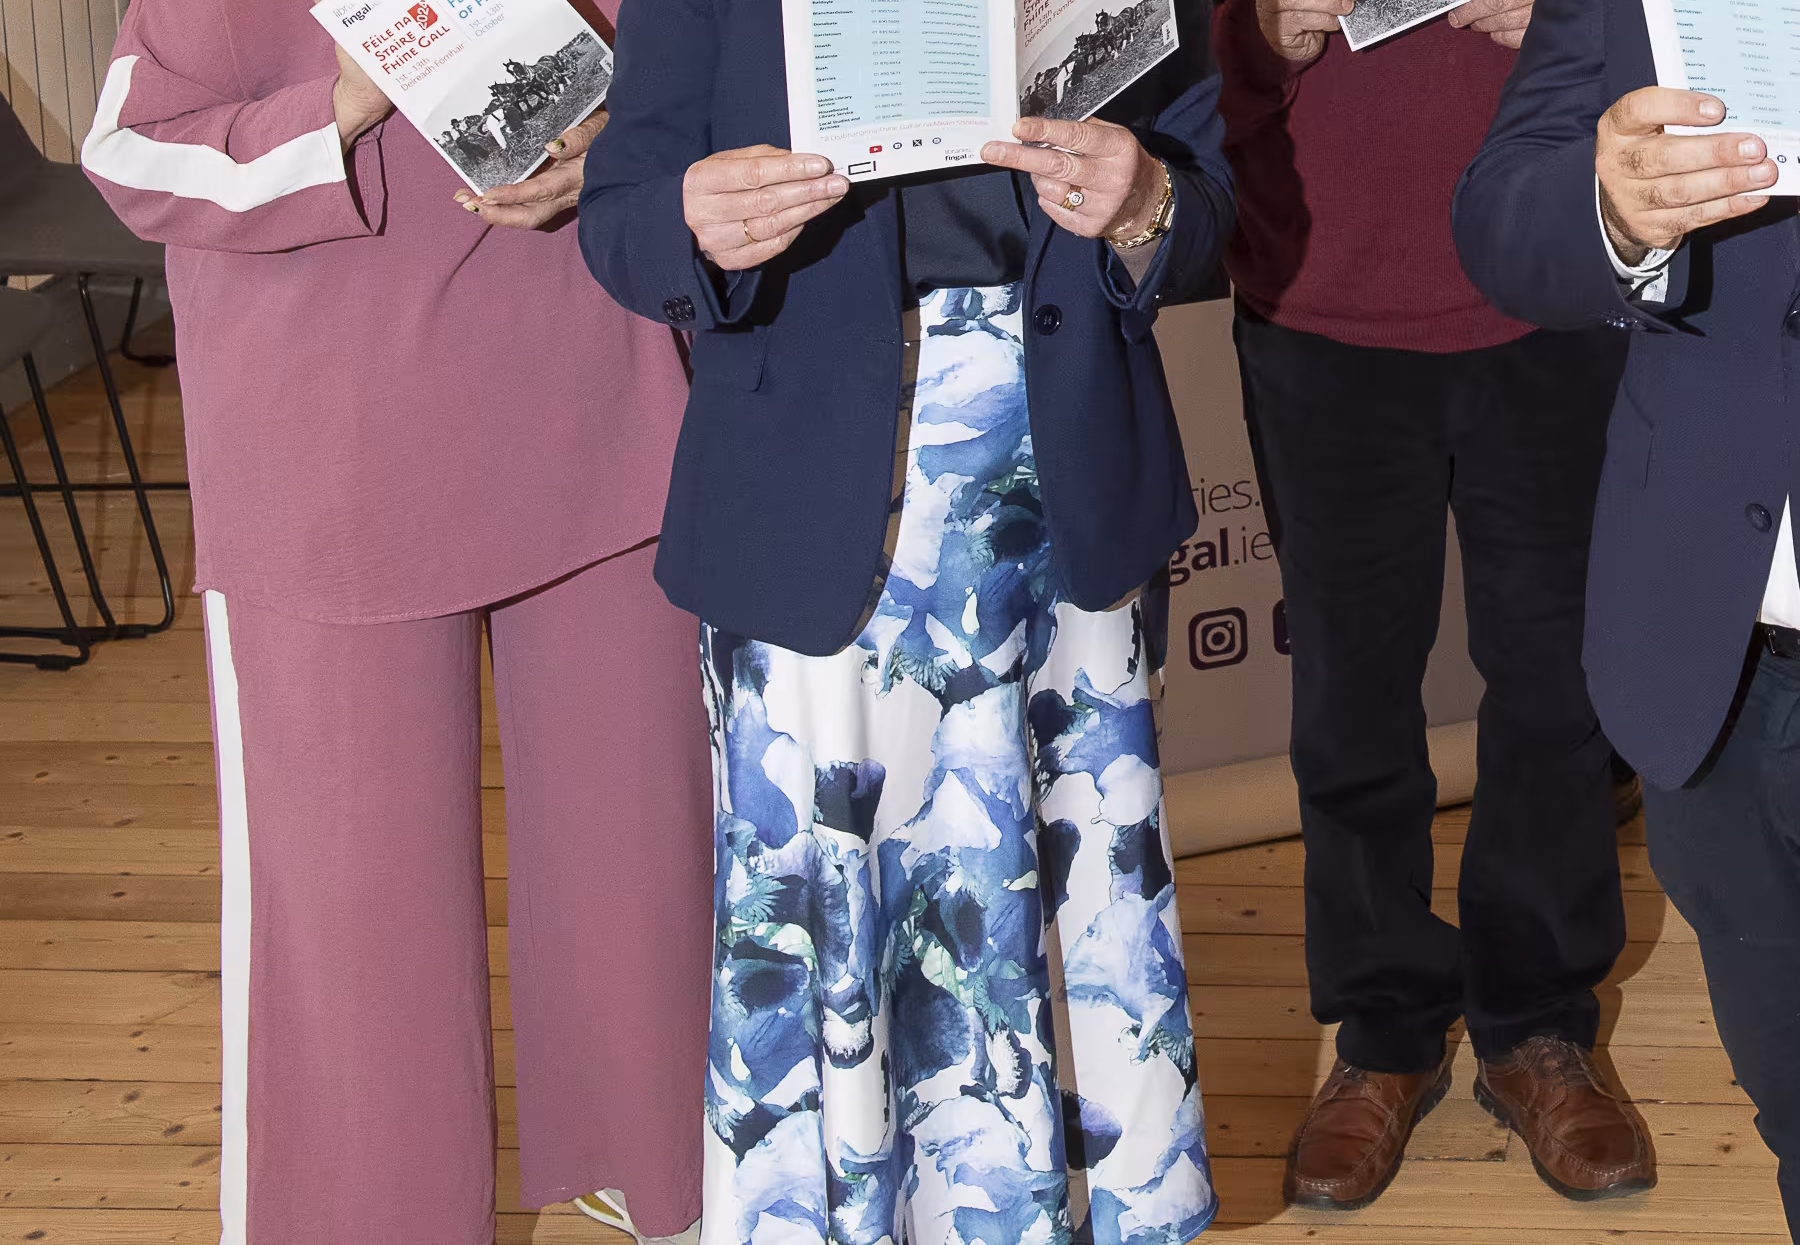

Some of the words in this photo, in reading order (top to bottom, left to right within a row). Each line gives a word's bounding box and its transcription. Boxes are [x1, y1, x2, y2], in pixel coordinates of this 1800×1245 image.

[458, 5, 473, 19] OF
[1024, 0, 1050, 31] FHINE
[375, 32, 416, 61] STAIRE
[382, 48, 418, 75] FHINE
[418, 26, 450, 47] GALL
[401, 63, 435, 92] Deireadh
[434, 43, 465, 67] Fómhair
